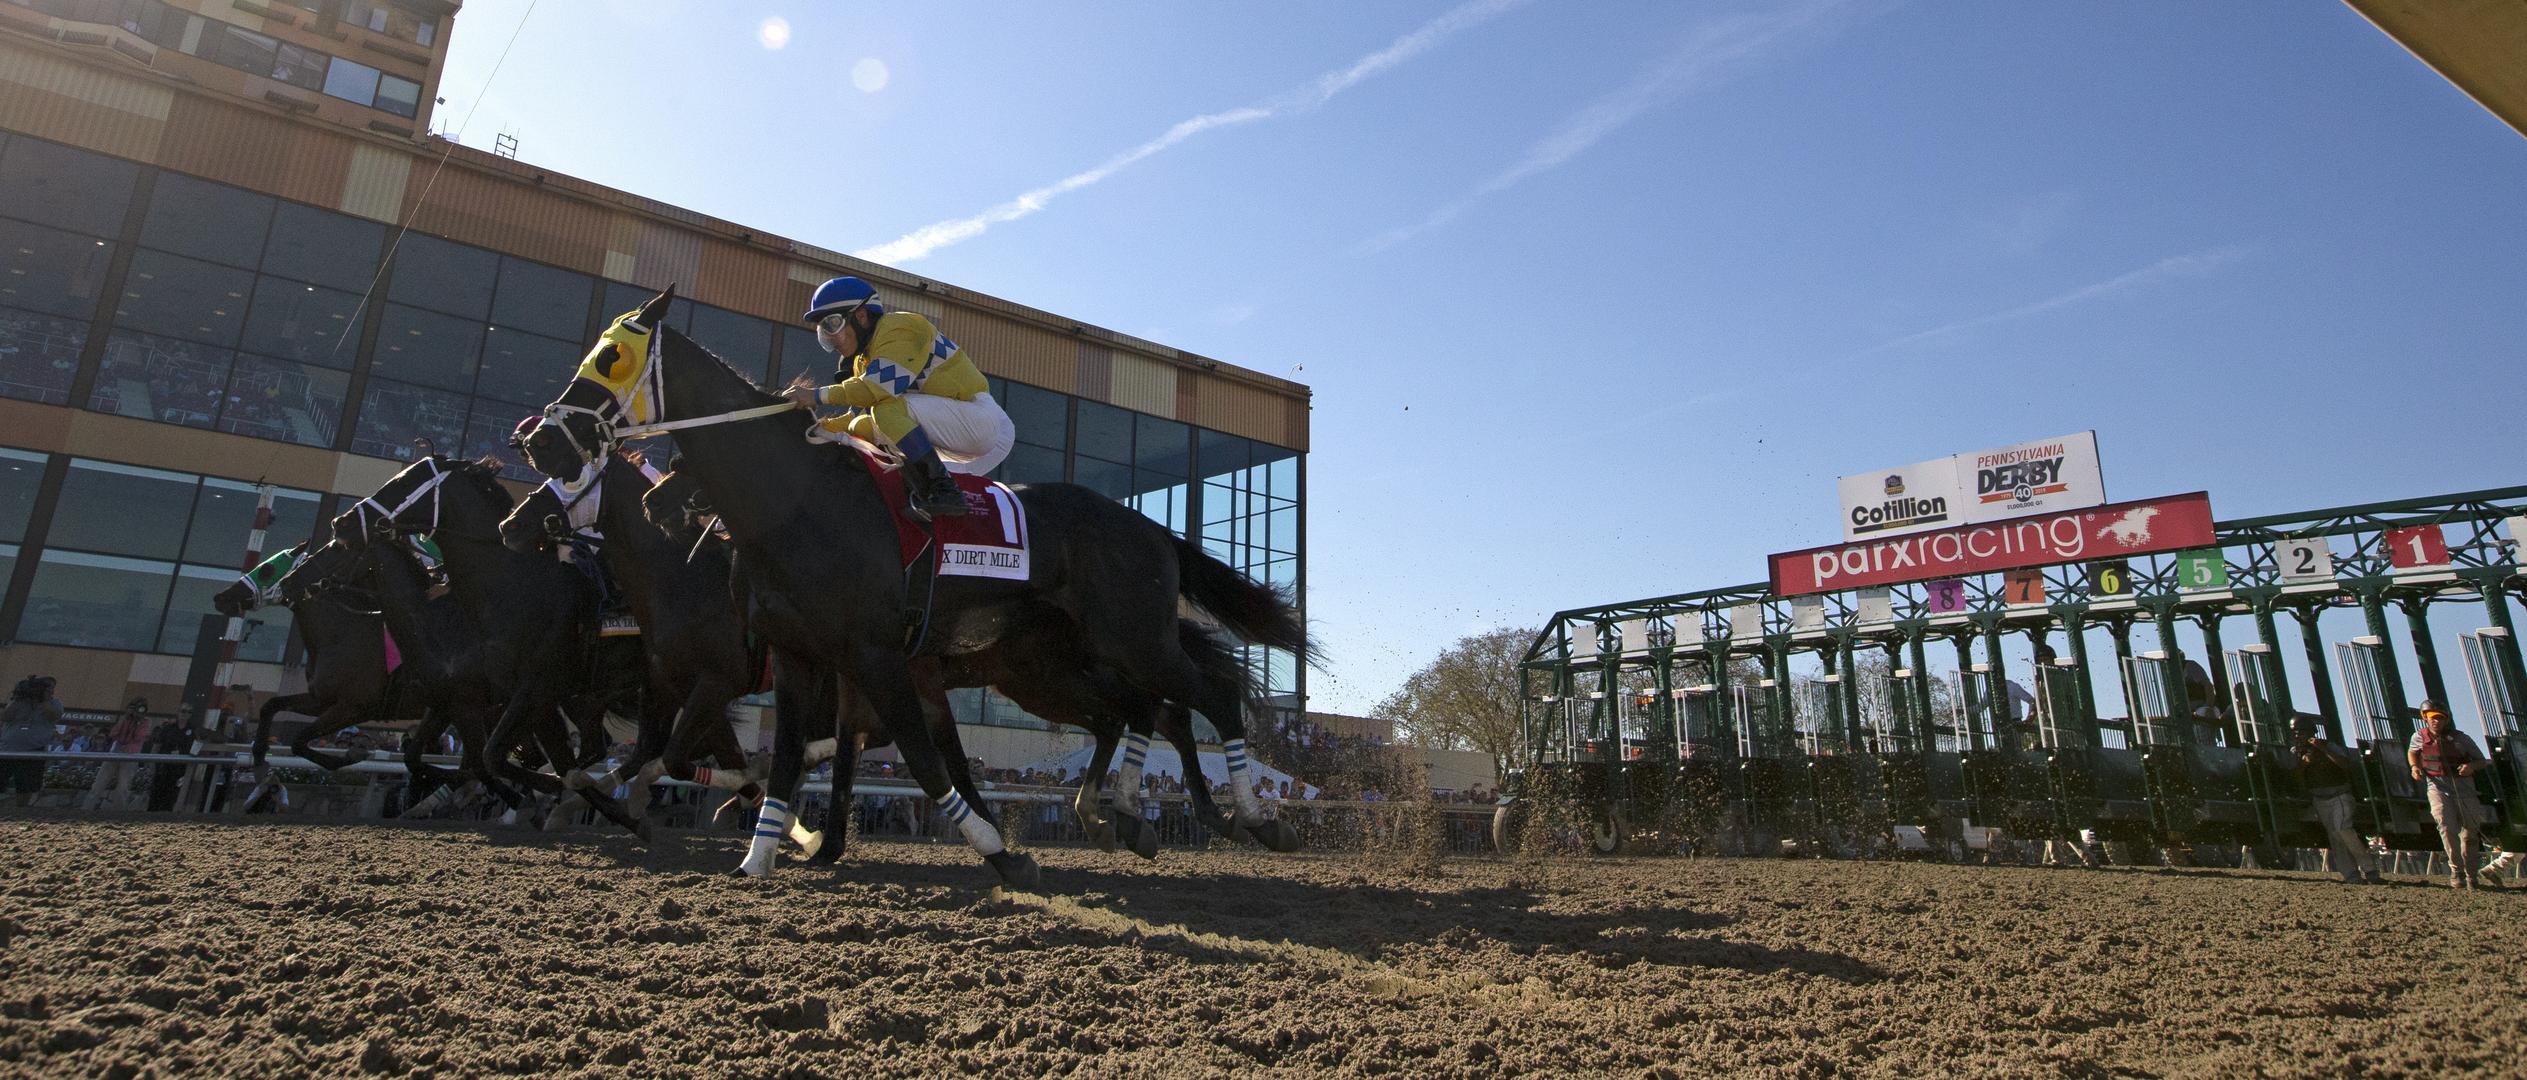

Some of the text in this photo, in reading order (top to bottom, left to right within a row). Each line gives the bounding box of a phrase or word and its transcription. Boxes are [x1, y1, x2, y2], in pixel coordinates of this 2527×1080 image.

[1977, 443, 2065, 468] PENNSYLVANIA
[1977, 456, 2065, 495] DERBY
[2015, 487, 2031, 499] 40
[985, 485, 1018, 545] 1
[1851, 496, 1947, 526] Cotillion
[955, 550, 987, 565] DIRT
[990, 553, 1021, 568] MILE
[2291, 547, 2316, 574] 2
[2407, 534, 2429, 564] 1
[2100, 568, 2119, 595] 6
[2192, 557, 2213, 584] 5
[1938, 587, 1956, 611] 8
[2014, 576, 2032, 602] 7
